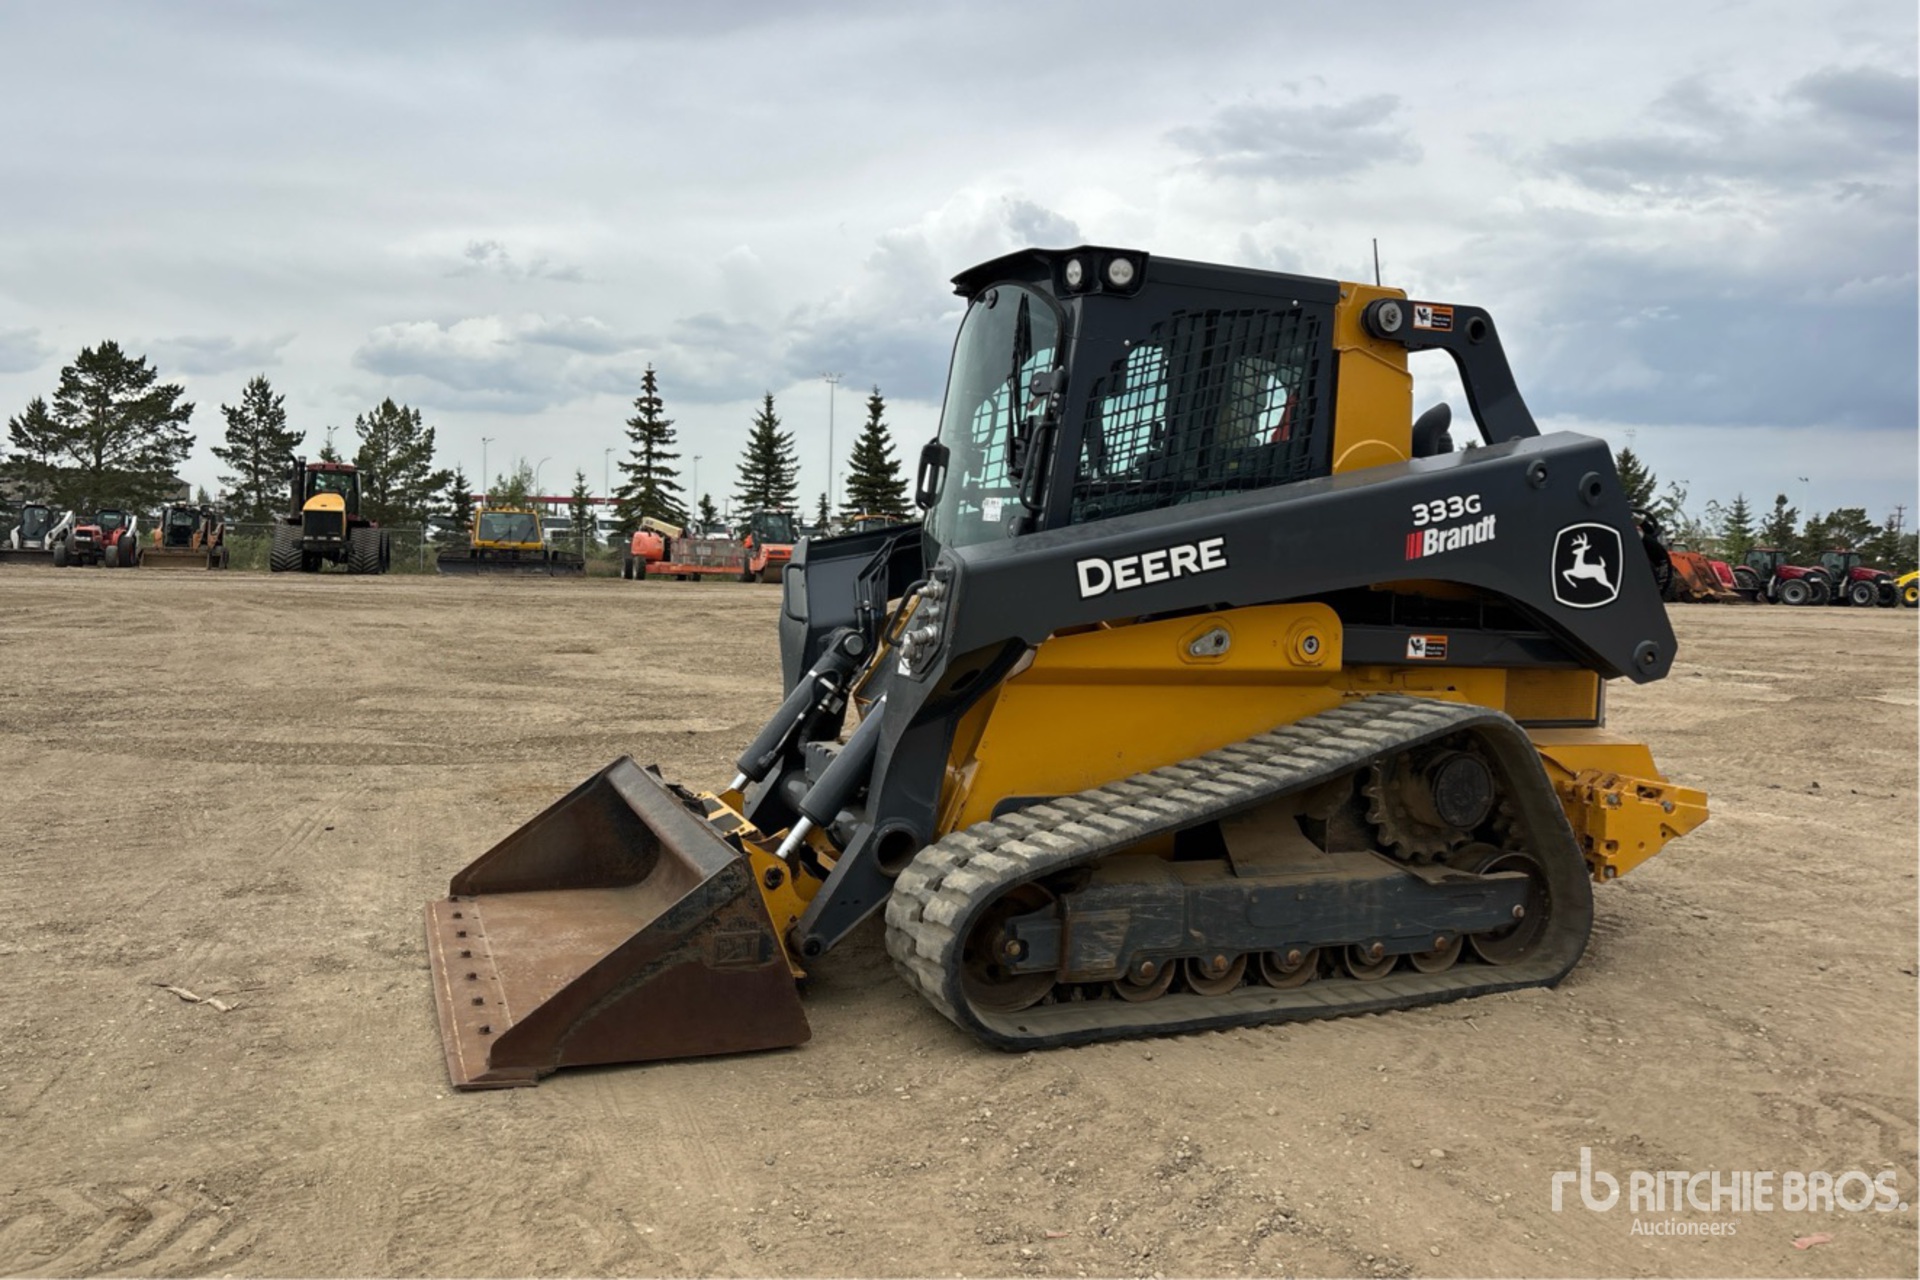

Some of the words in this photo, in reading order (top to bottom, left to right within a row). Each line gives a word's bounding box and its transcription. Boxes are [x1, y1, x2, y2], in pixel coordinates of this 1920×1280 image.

[1411, 494, 1482, 526] 333G
[1423, 514, 1497, 557] Brandt
[1076, 537, 1228, 598] DEERE
